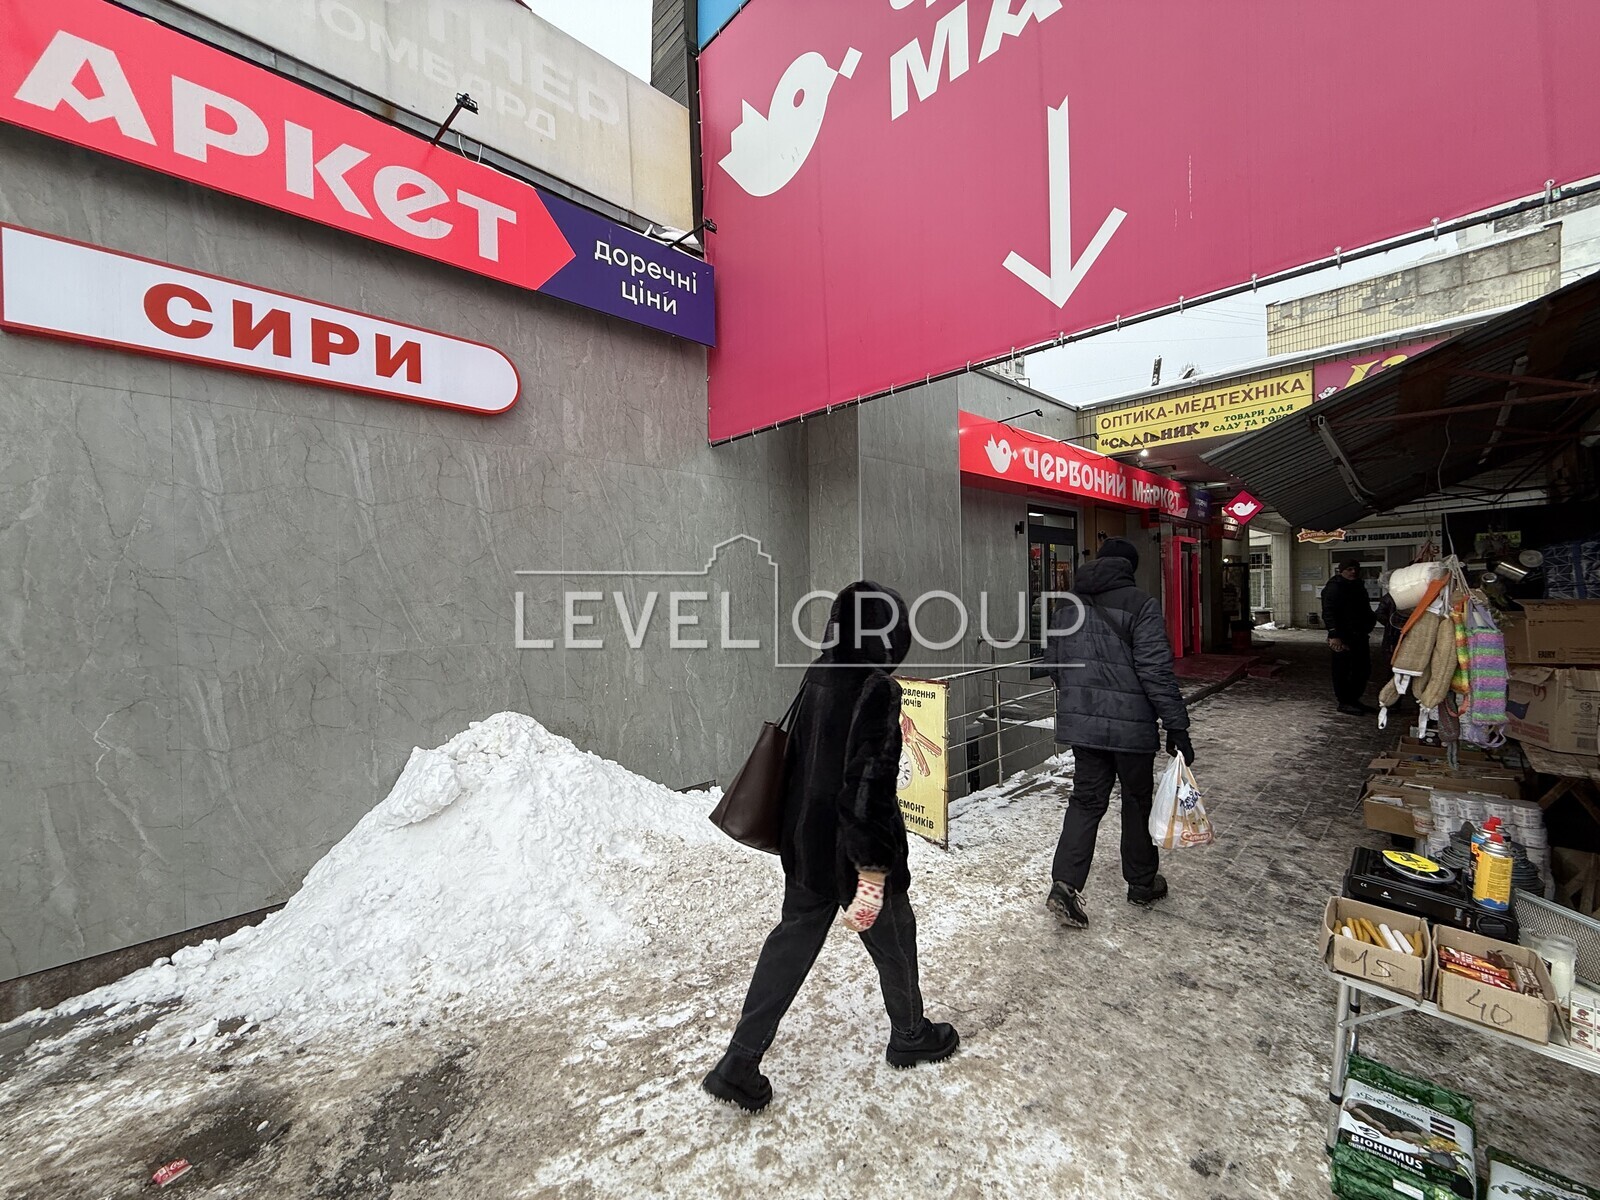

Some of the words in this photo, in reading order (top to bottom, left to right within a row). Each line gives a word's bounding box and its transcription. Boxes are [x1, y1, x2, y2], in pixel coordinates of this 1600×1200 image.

[594, 239, 698, 296] доречні
[620, 280, 678, 316] ціни
[143, 282, 422, 385] СИРИ
[1101, 378, 1305, 430] ОПТИКА-МЕДТЕХНІКА
[1269, 404, 1293, 415] ДЛЯ
[1213, 421, 1241, 432] САДУ
[1244, 419, 1258, 427] ТА
[901, 698, 922, 708] ючів
[902, 688, 936, 699] овлення
[898, 799, 926, 814] емонт
[1352, 949, 1405, 978] 15
[1465, 988, 1513, 1027] 40
[1351, 1133, 1424, 1170] BIOHUMUS
